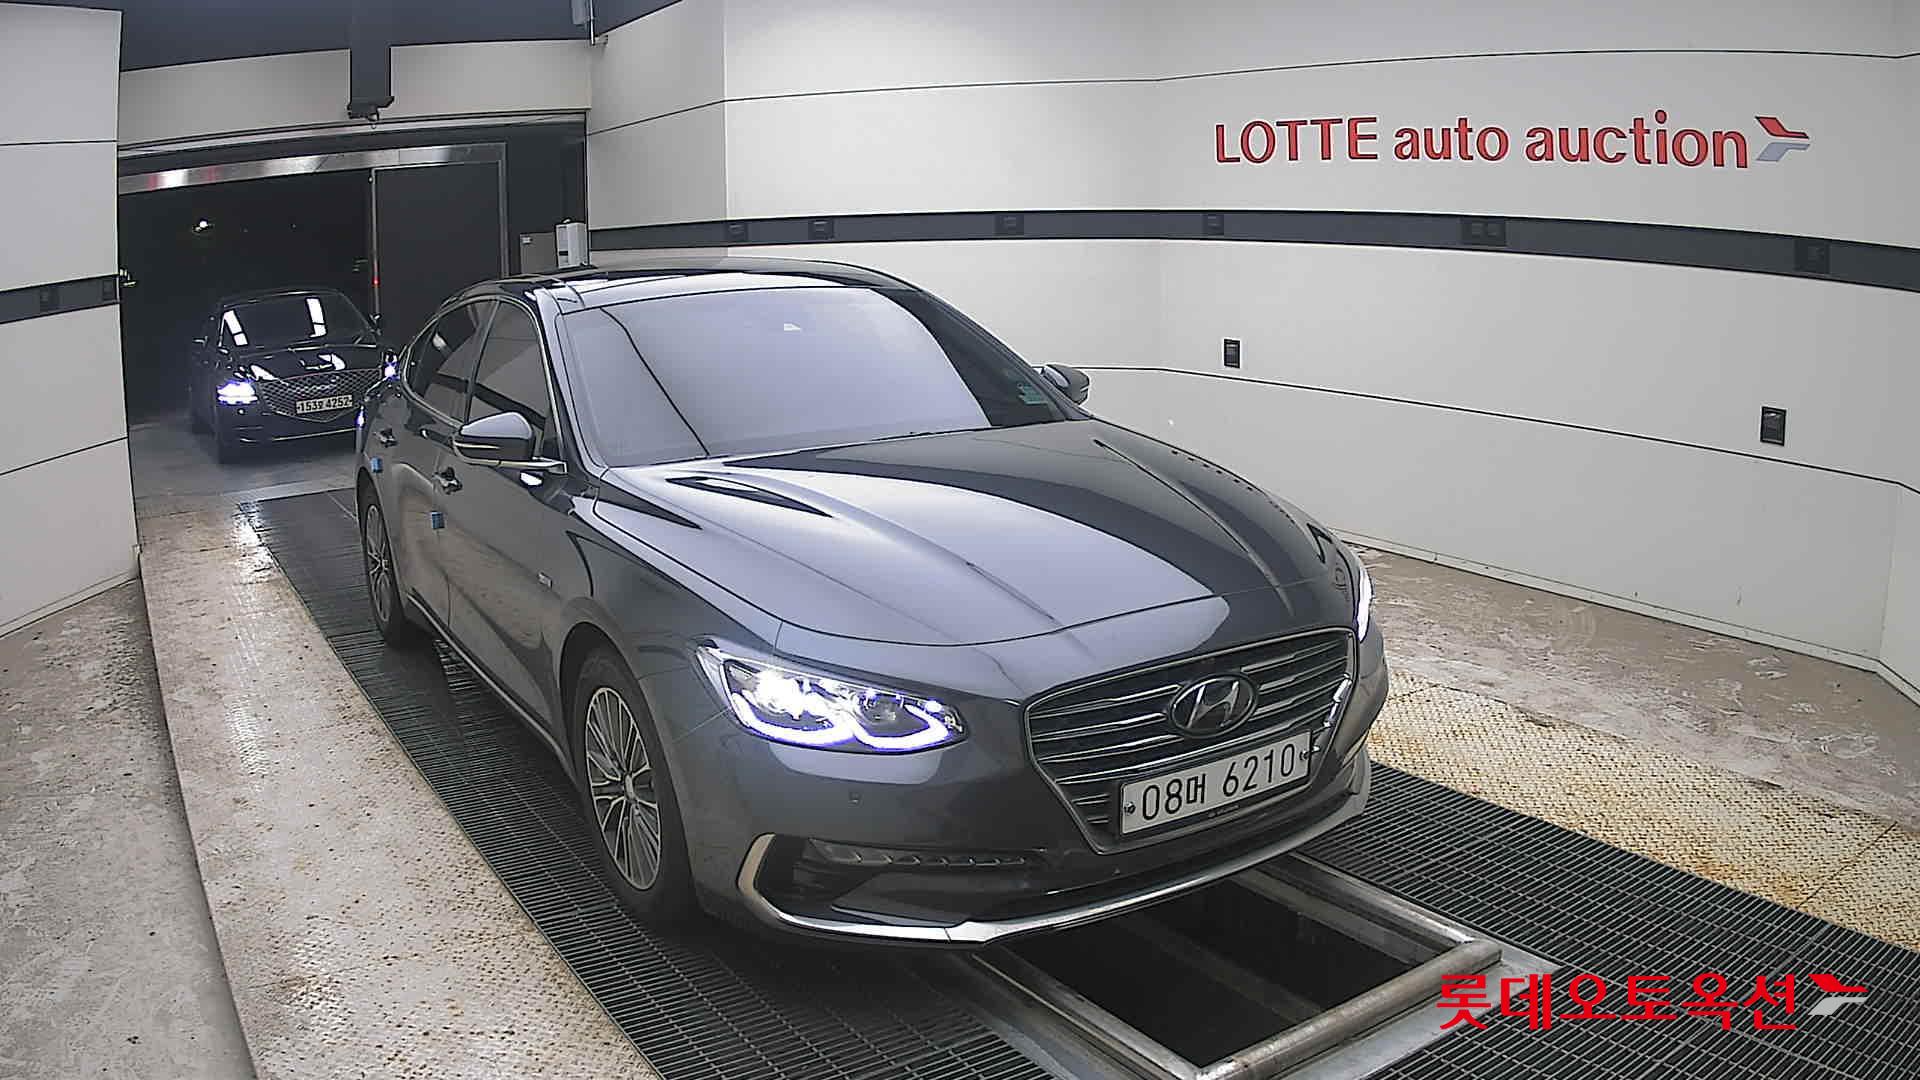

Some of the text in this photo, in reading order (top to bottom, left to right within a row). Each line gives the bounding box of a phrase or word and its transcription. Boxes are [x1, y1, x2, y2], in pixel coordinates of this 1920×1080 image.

[1215, 110, 1750, 168] LOTTE auto auction
[1142, 743, 1295, 821] 08머 6210
